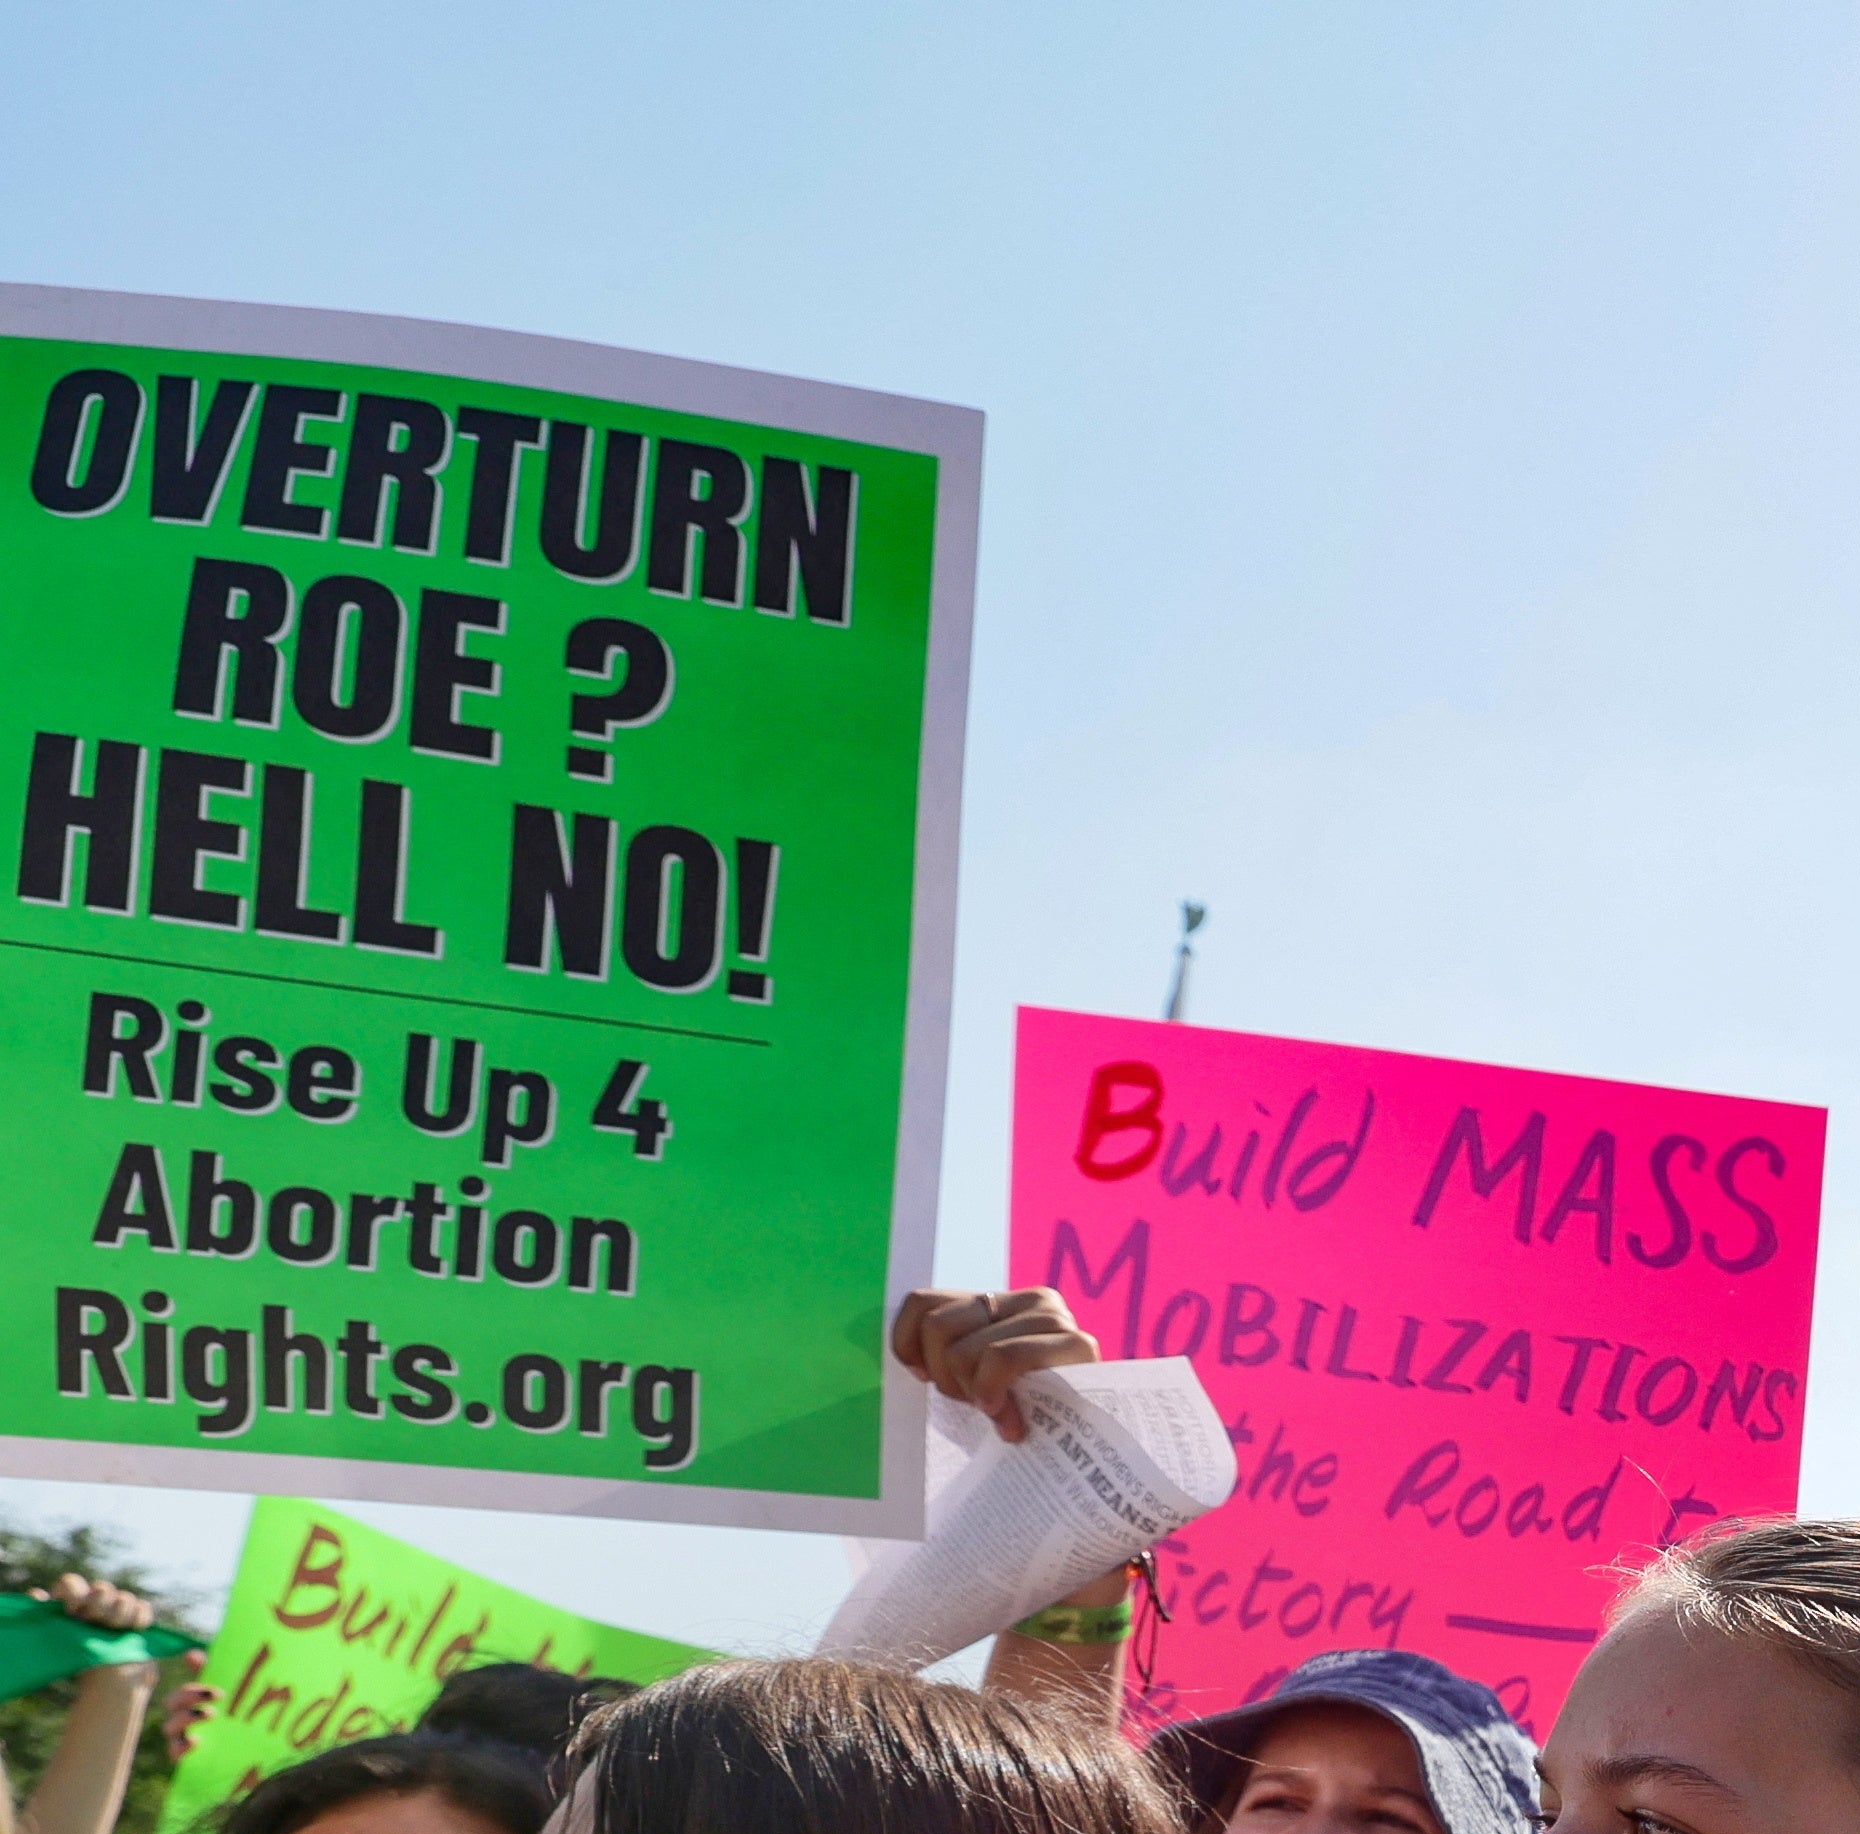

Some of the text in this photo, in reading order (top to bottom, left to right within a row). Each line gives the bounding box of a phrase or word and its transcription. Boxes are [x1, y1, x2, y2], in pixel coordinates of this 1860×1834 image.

[28, 366, 860, 628] OVERTURN
[170, 556, 675, 782] ROE ?
[17, 730, 781, 1005] HELL NO!
[81, 990, 672, 1167] Rise Up 4
[90, 1142, 639, 1296] Abortion
[1074, 1060, 1787, 1275] Build MASS
[53, 1285, 701, 1469] Rights.org
[1086, 1465, 1158, 1535] MEANS
[1384, 1438, 1626, 1543] Road
[1154, 1538, 1414, 1649] ictory
[225, 1640, 408, 1750] Inde
